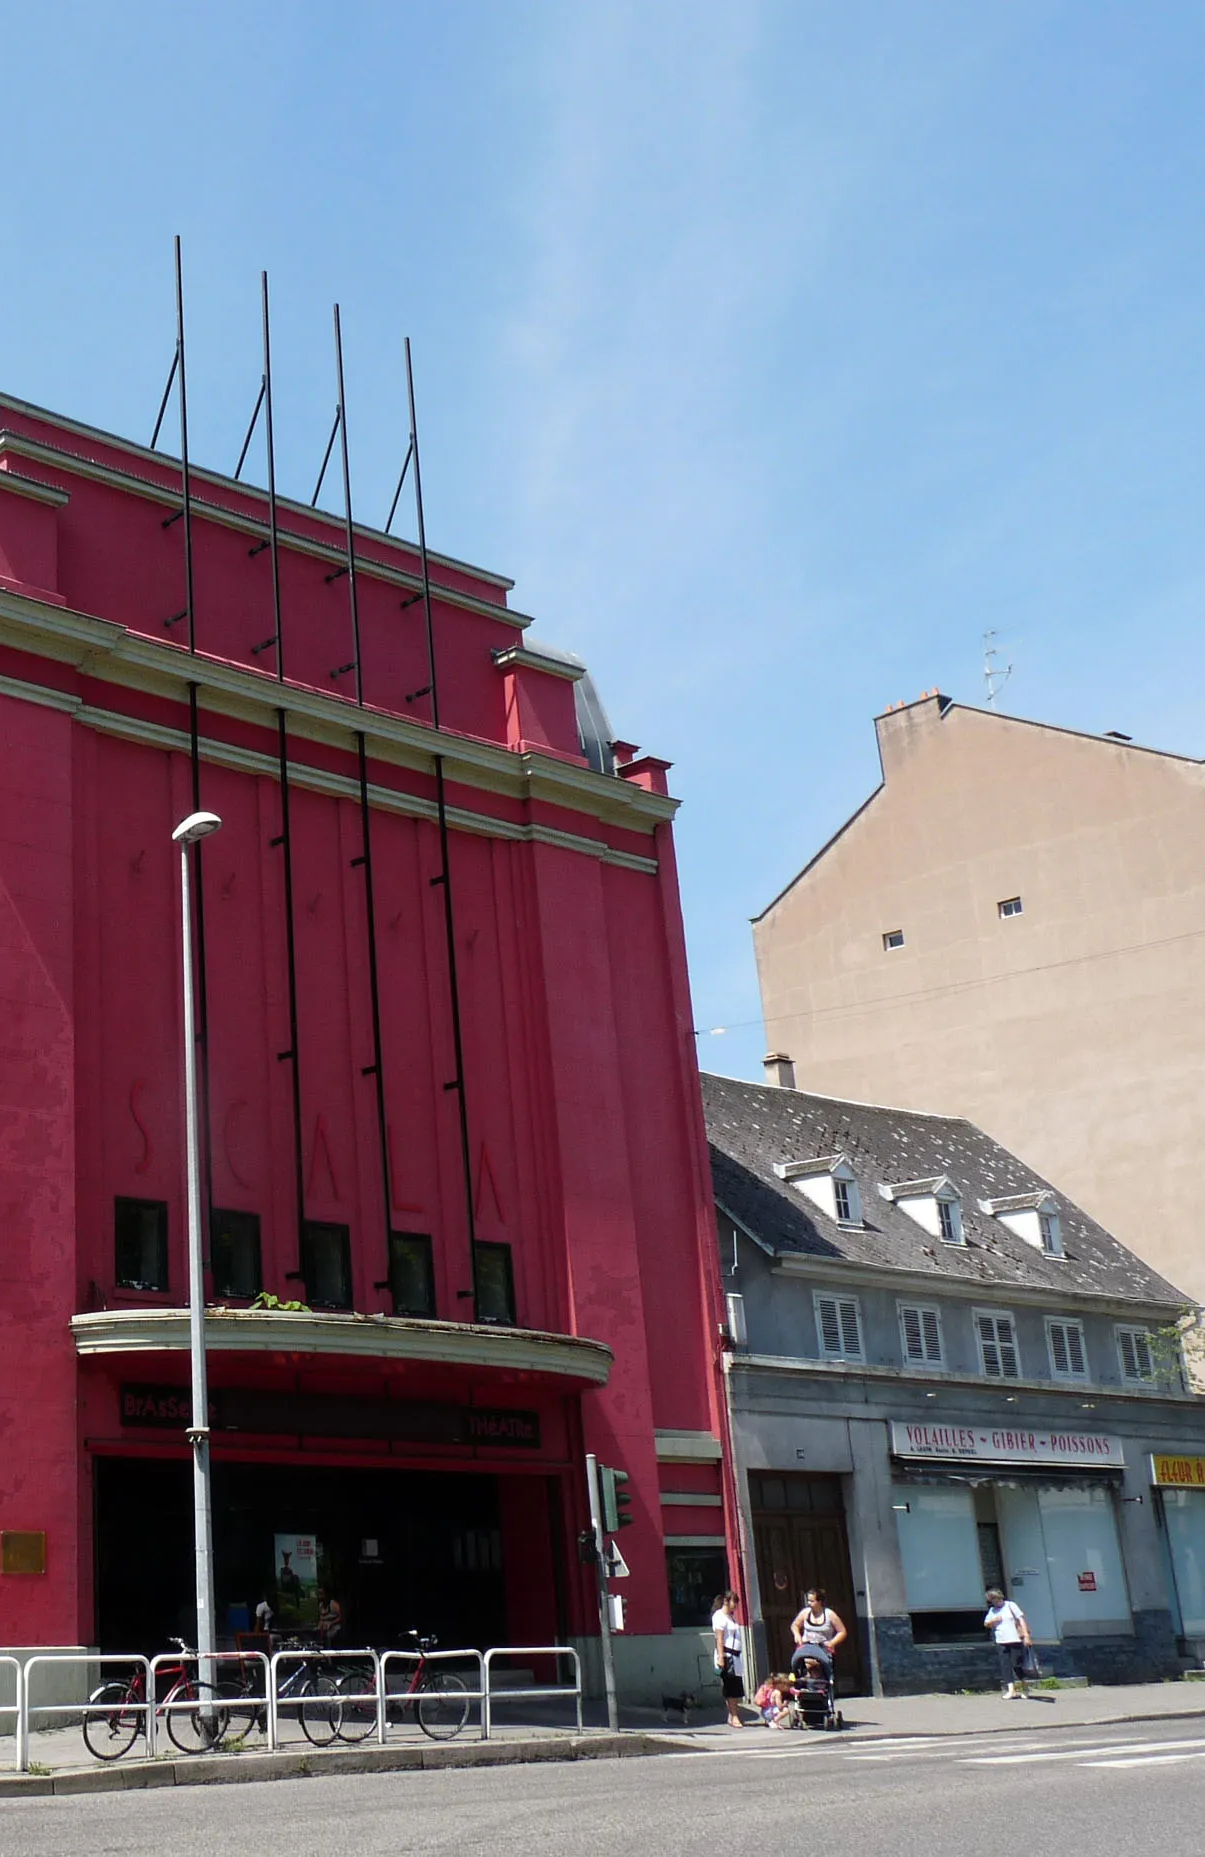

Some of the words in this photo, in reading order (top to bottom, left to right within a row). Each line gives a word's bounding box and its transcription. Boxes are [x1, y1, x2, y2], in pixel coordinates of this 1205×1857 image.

[906, 1425, 975, 1448] VOLAILLES
[992, 1430, 1037, 1452] GIBIER
[1050, 1434, 1110, 1455] POISSONS
